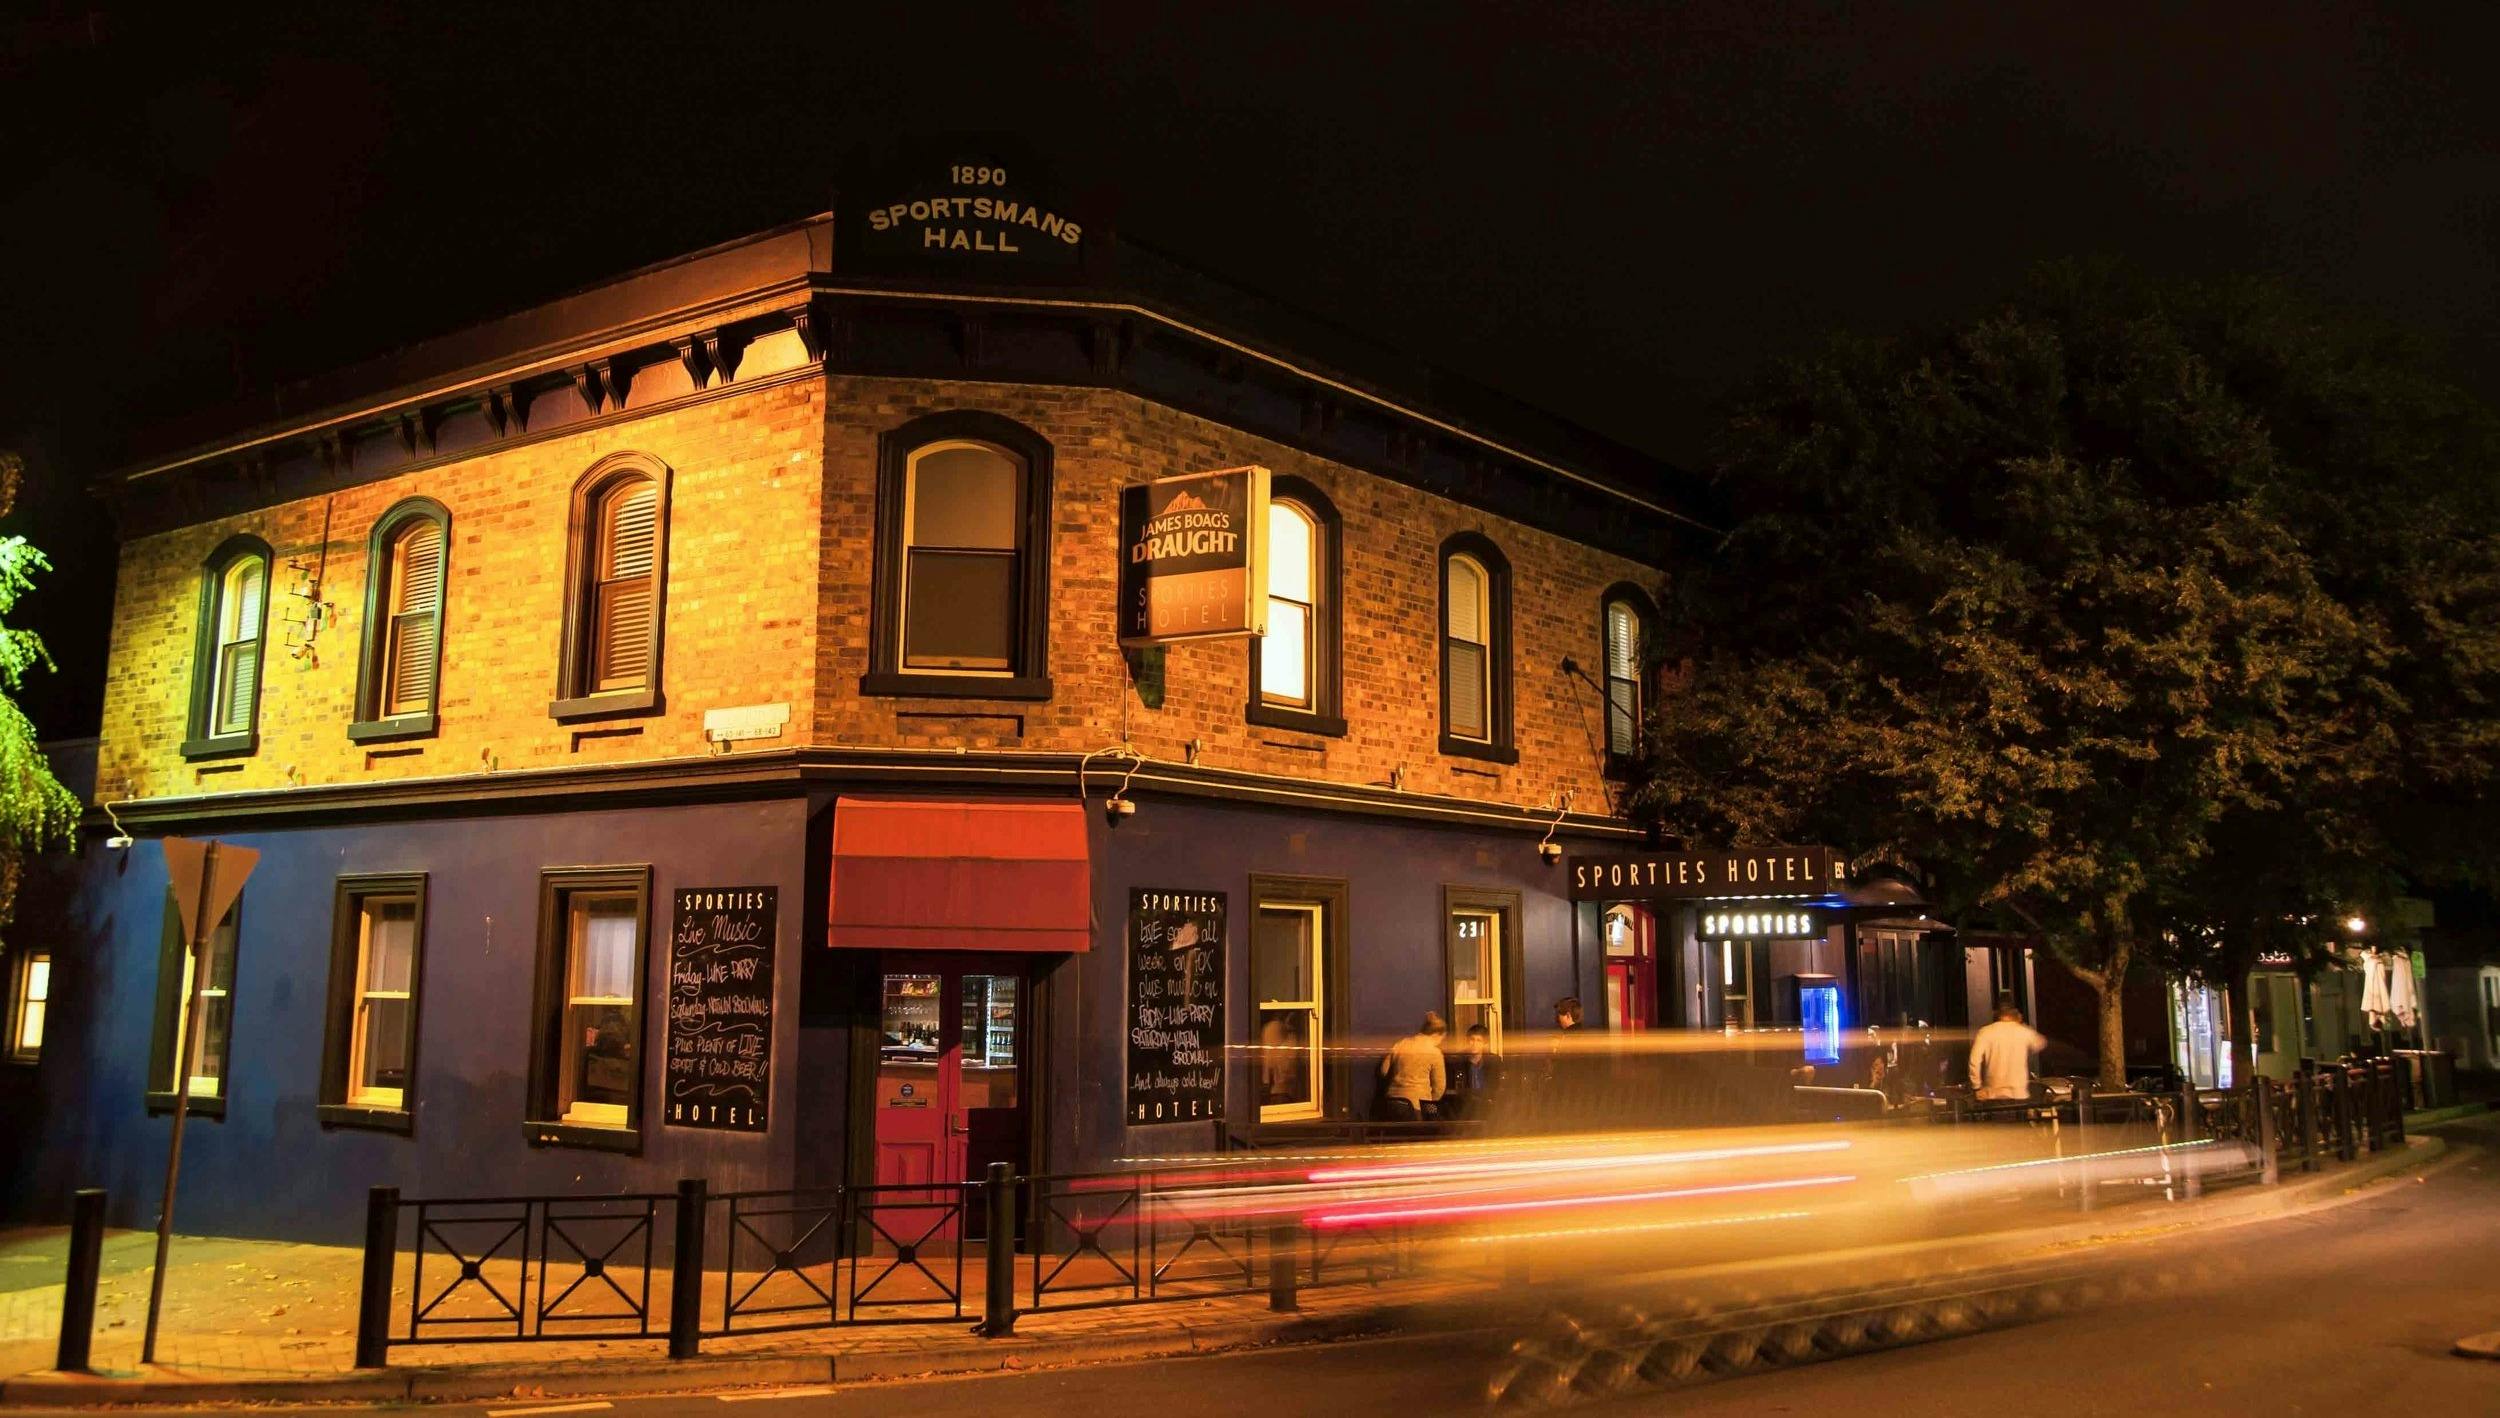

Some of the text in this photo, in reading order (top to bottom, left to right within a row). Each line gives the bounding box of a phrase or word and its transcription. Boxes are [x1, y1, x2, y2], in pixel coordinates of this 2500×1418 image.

[951, 165, 1006, 186] 1890
[868, 197, 1082, 244] SPORTSMANS
[924, 227, 1019, 252] HALL
[1141, 512, 1230, 542] JAMES BOAG'S
[1132, 530, 1238, 564] DRAUGHT
[1137, 602, 1227, 631] HOTEL
[1577, 860, 1705, 888] SPORTIES
[1728, 857, 1813, 882] HOTEL
[685, 892, 763, 910] SPORTIES
[1142, 893, 1216, 912] SPORTIES
[1704, 913, 1811, 935] SPORTIES
[675, 1103, 754, 1125] HOTEL
[1139, 1100, 1213, 1120] HOTEL
